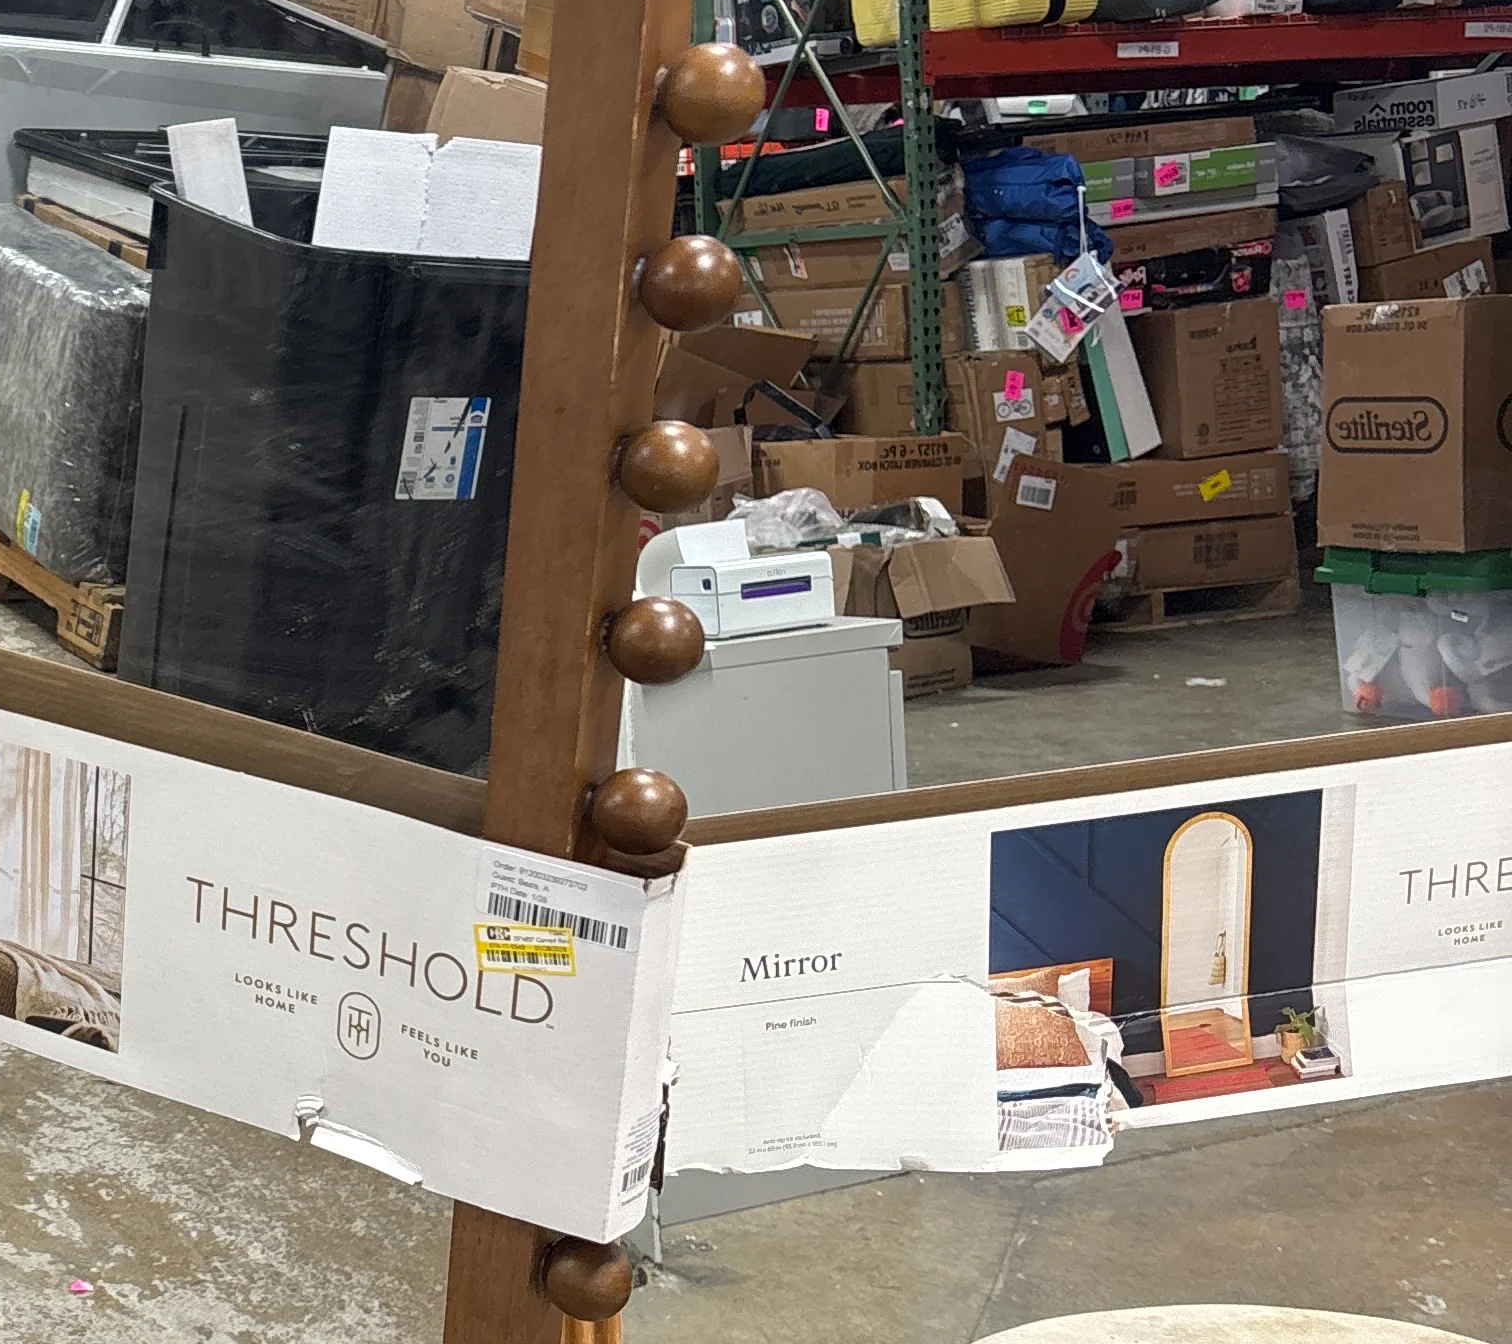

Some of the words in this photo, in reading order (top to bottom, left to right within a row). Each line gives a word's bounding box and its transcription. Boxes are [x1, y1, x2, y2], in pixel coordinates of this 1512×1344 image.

[1438, 924, 1475, 937] LOOKS
[1479, 920, 1503, 931] LIKE
[187, 876, 553, 1024] THRESHOLD
[1453, 934, 1486, 946] HOME
[739, 952, 842, 982] Mirror
[235, 973, 284, 998] LOOKS
[287, 985, 319, 1005] LIKE
[254, 993, 296, 1014] HOME
[766, 1019, 787, 1031] Pine
[789, 1016, 817, 1029] finish
[401, 1023, 441, 1049] FEELS
[445, 1040, 479, 1061] LIKE
[423, 1048, 451, 1068] YOU
